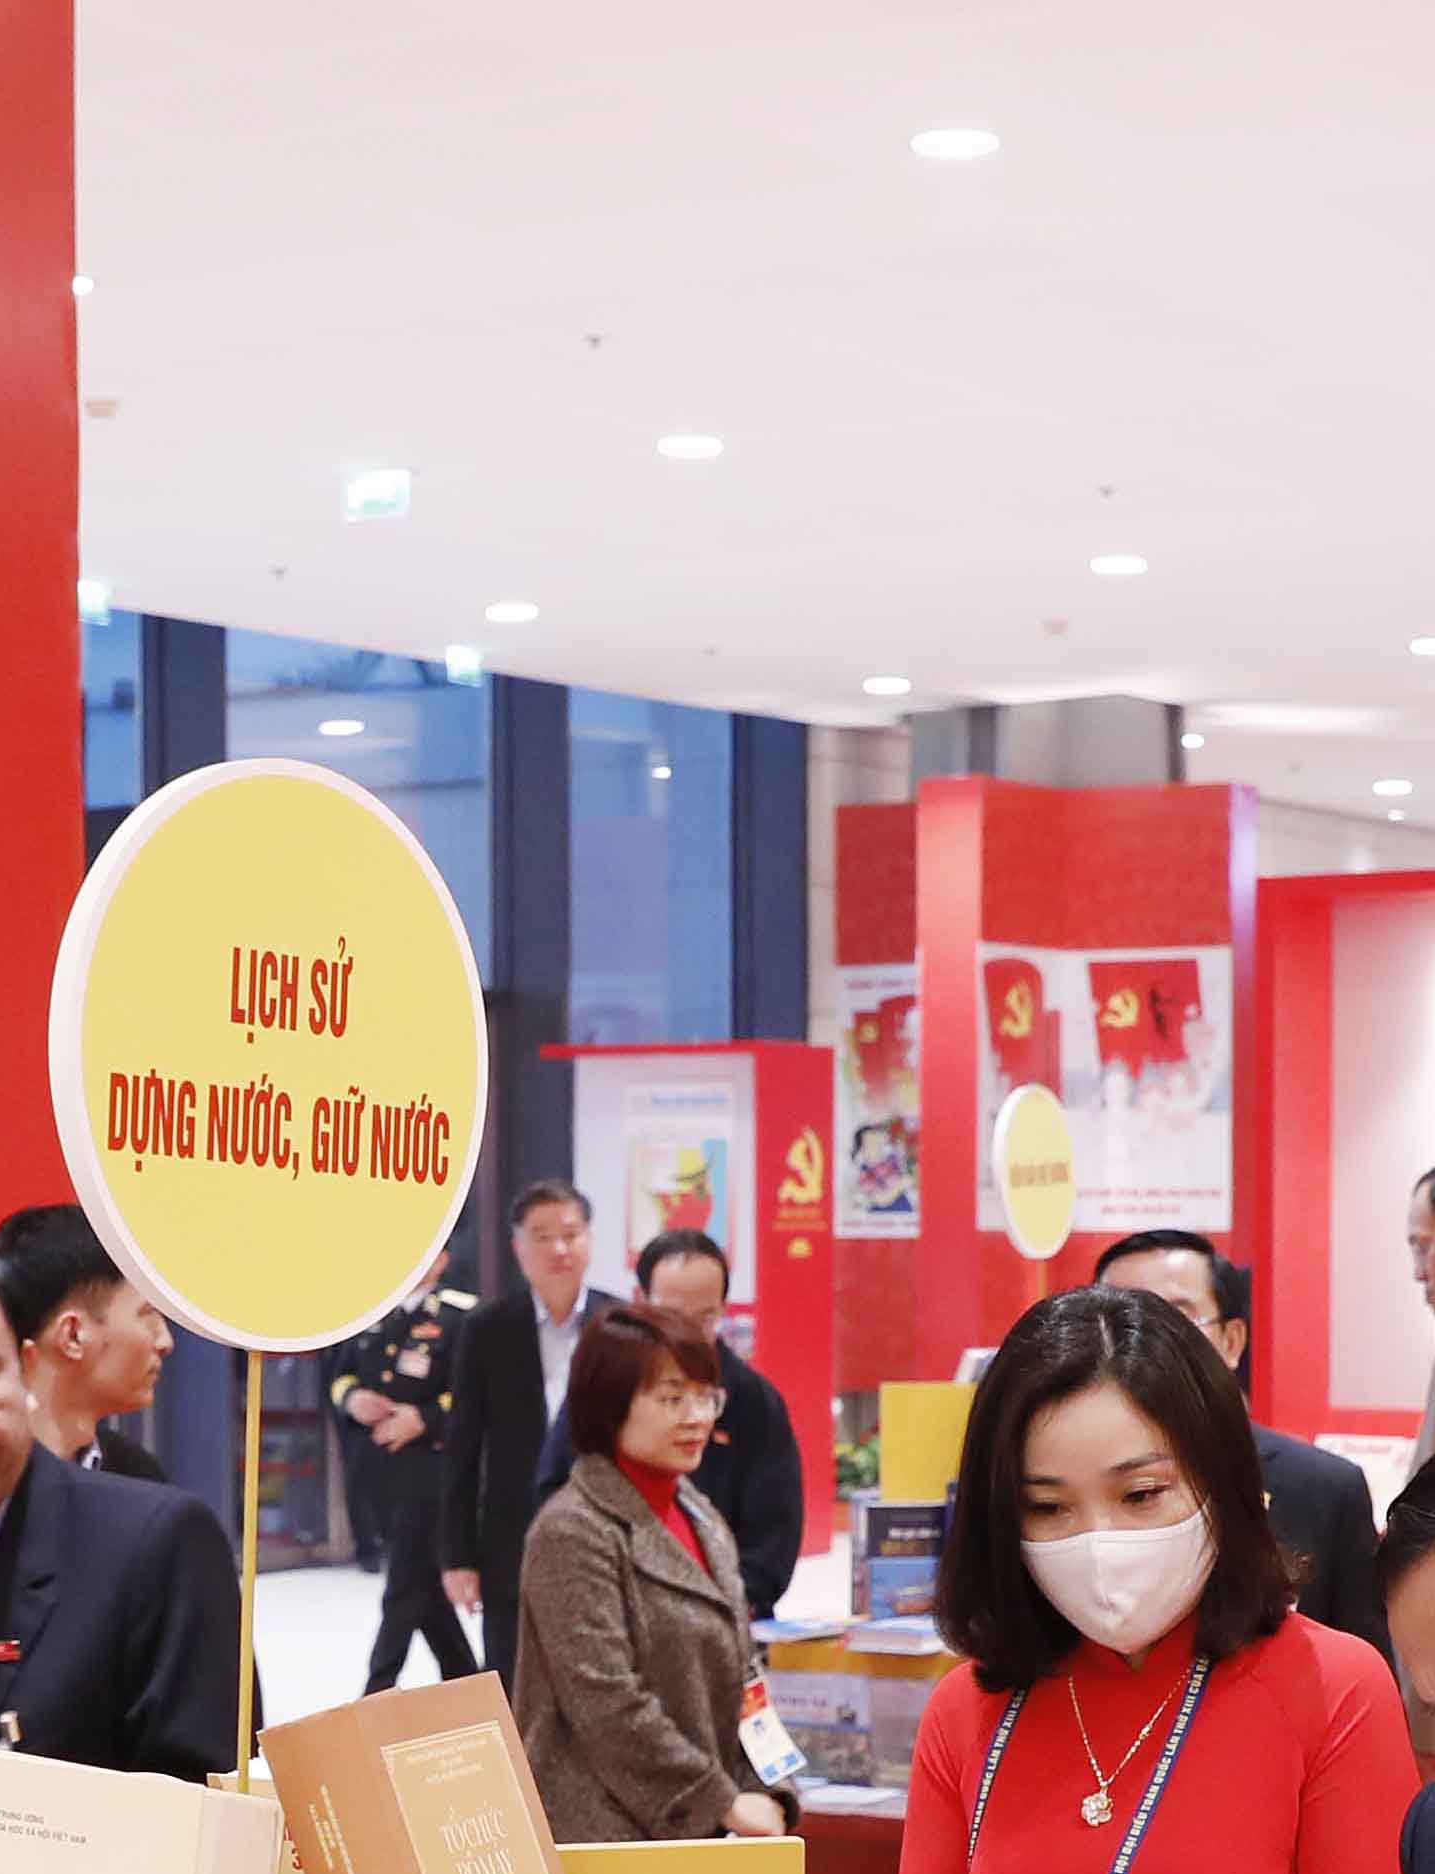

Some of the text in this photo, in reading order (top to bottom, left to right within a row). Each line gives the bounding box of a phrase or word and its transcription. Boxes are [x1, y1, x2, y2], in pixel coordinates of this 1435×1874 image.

[230, 936, 354, 1043] LỊCH SỬ
[107, 1068, 450, 1186] DỰNG NƯỚC, GIỮ NƯỚC
[1184, 1693, 1199, 1716] XIII
